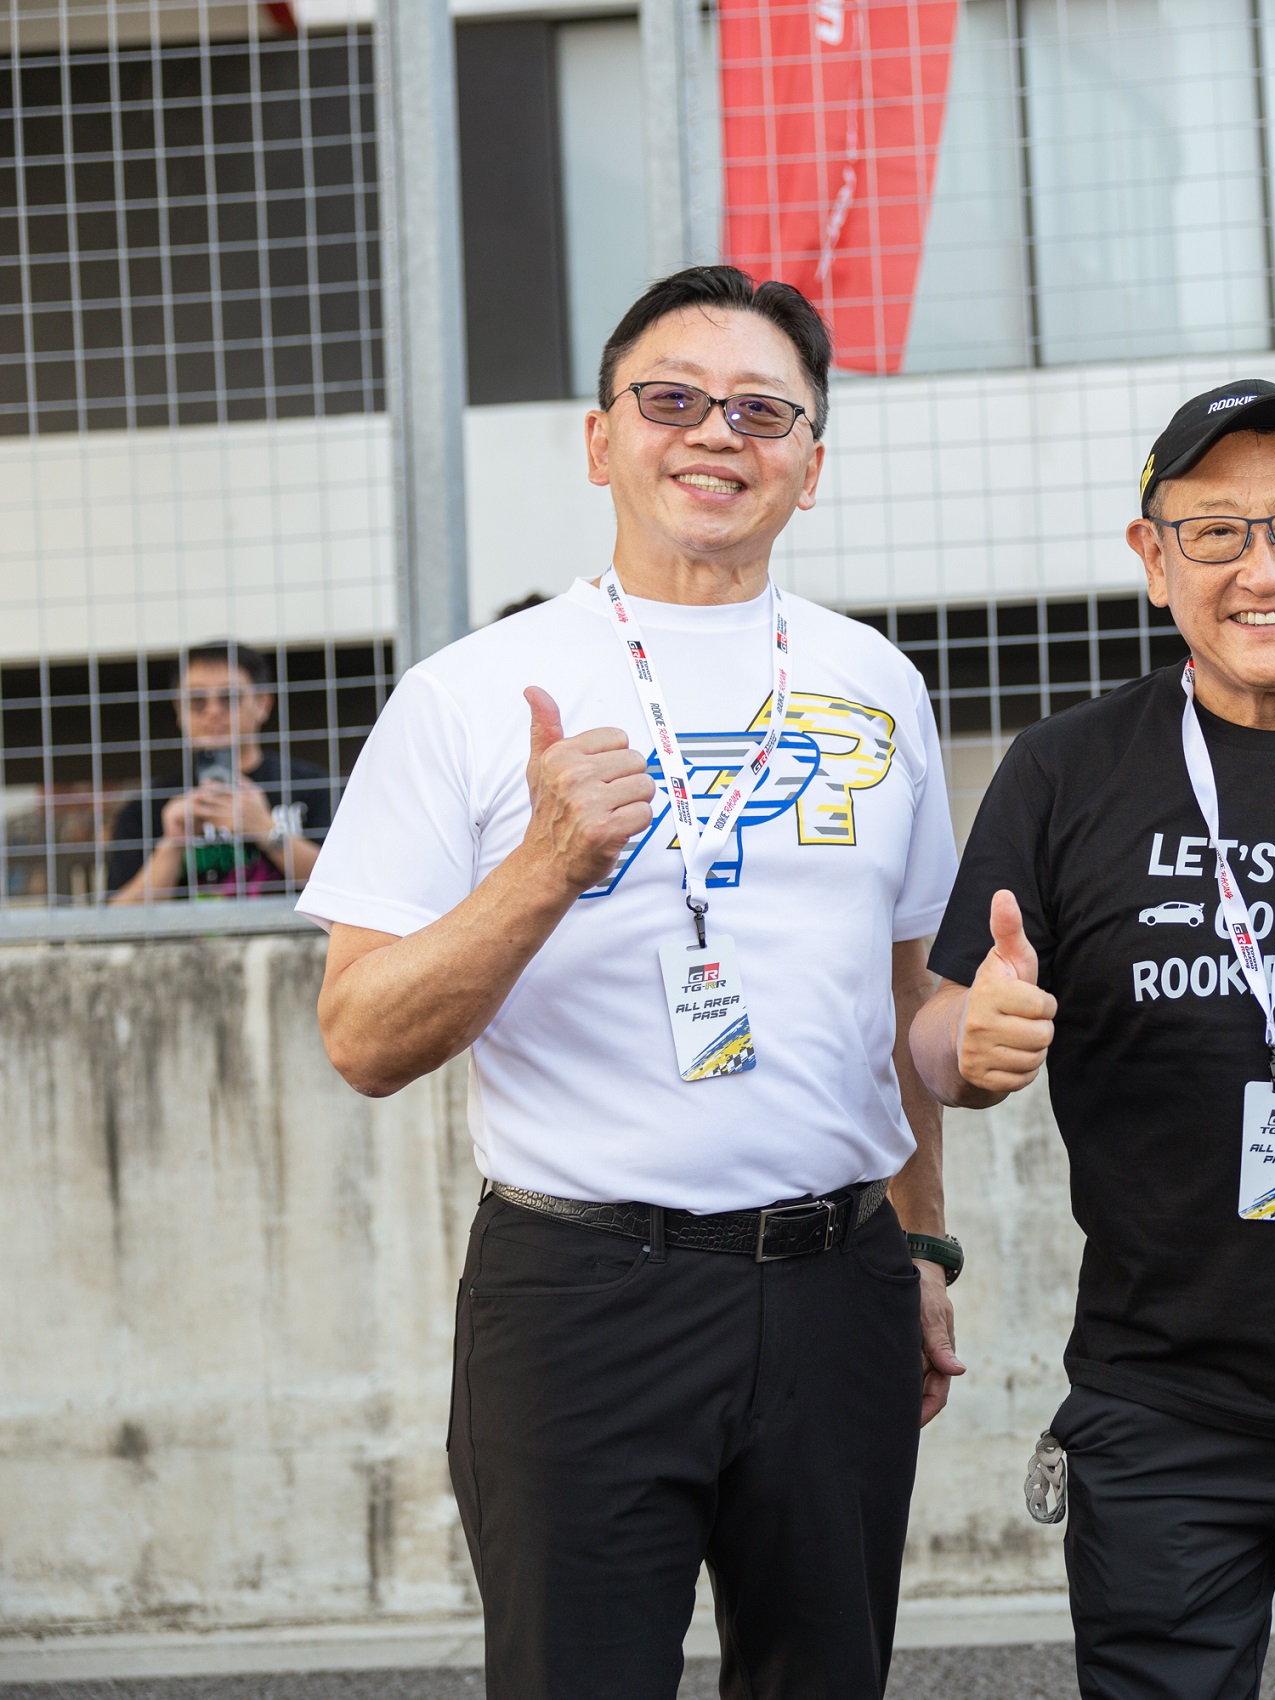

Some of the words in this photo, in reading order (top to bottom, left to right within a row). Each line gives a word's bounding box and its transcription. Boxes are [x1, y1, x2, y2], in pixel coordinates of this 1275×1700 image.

[650, 702, 666, 727] ROOKIE
[714, 811, 730, 831] ROOKIE
[1148, 833, 1275, 883] LET'S
[688, 966, 719, 984] GR
[675, 1002, 700, 1013] ALL
[703, 995, 740, 1009] AREA
[692, 1008, 728, 1022] PASS
[1249, 1143, 1274, 1153] ALL
